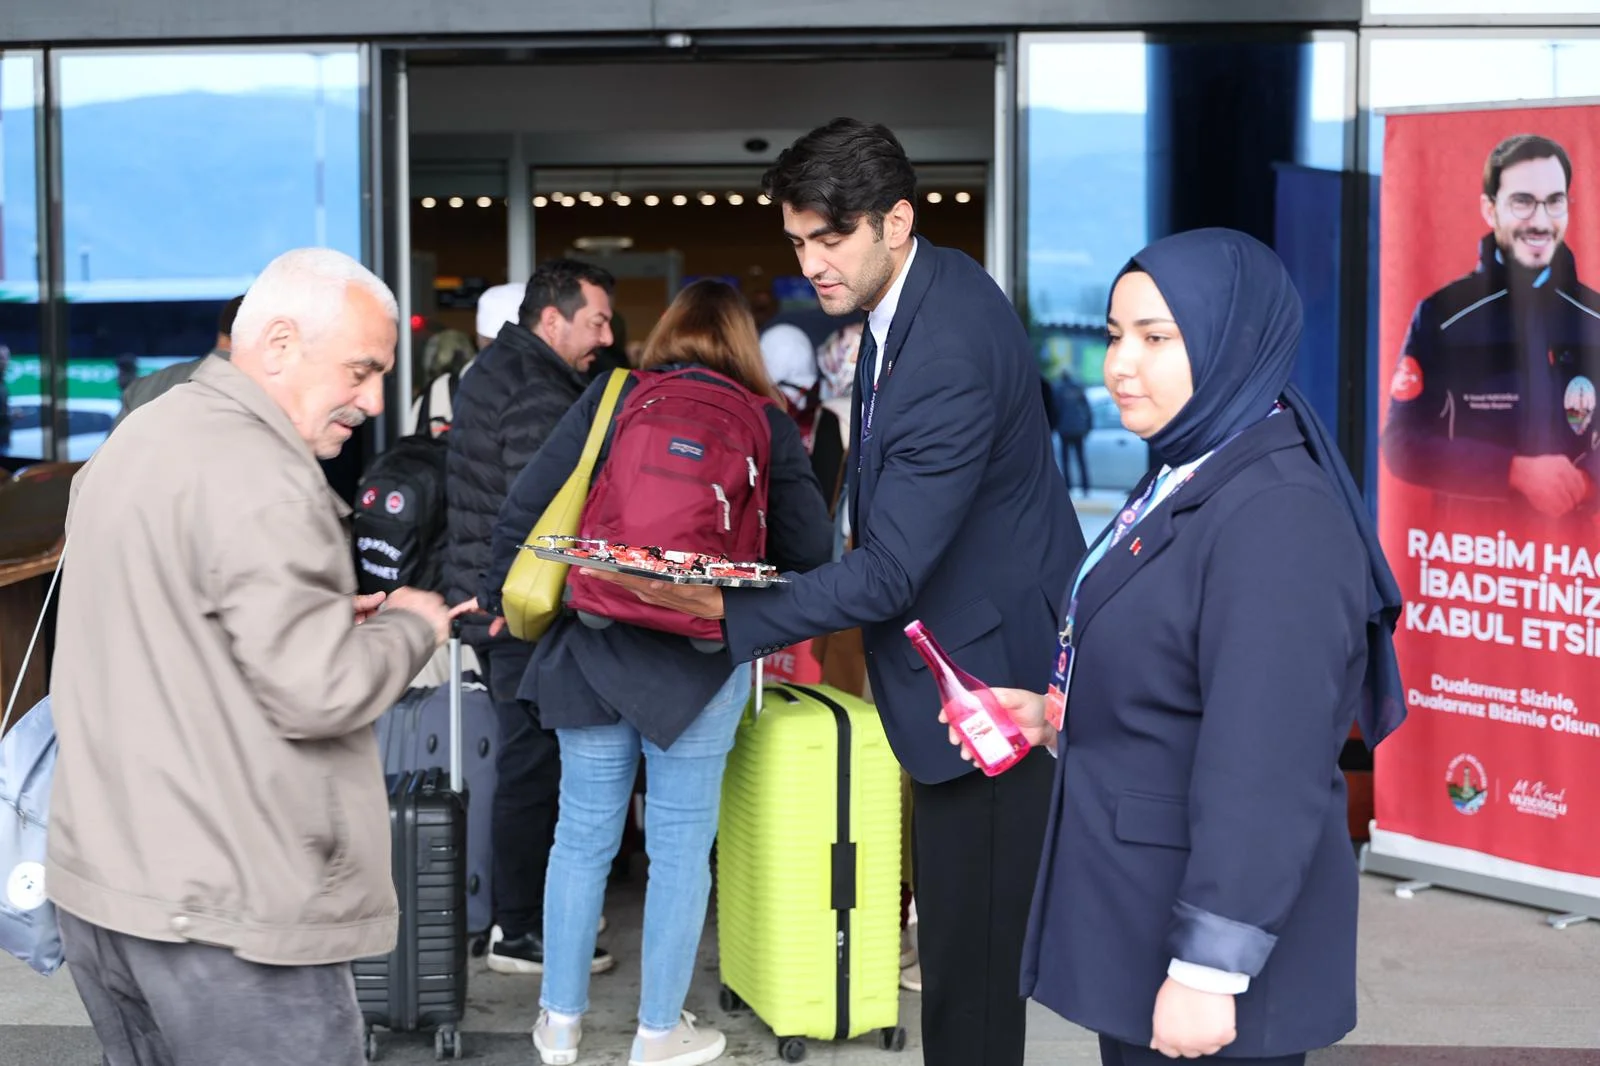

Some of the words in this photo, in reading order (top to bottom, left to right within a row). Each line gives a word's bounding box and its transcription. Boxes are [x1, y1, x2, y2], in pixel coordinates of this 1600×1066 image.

[1408, 528, 1535, 572] RABBİM
[1420, 559, 1600, 619] İBADETİNİZ
[1406, 601, 1515, 645] KABUL
[1522, 617, 1600, 658] ETSİ
[1488, 702, 1547, 729] Bizimle
